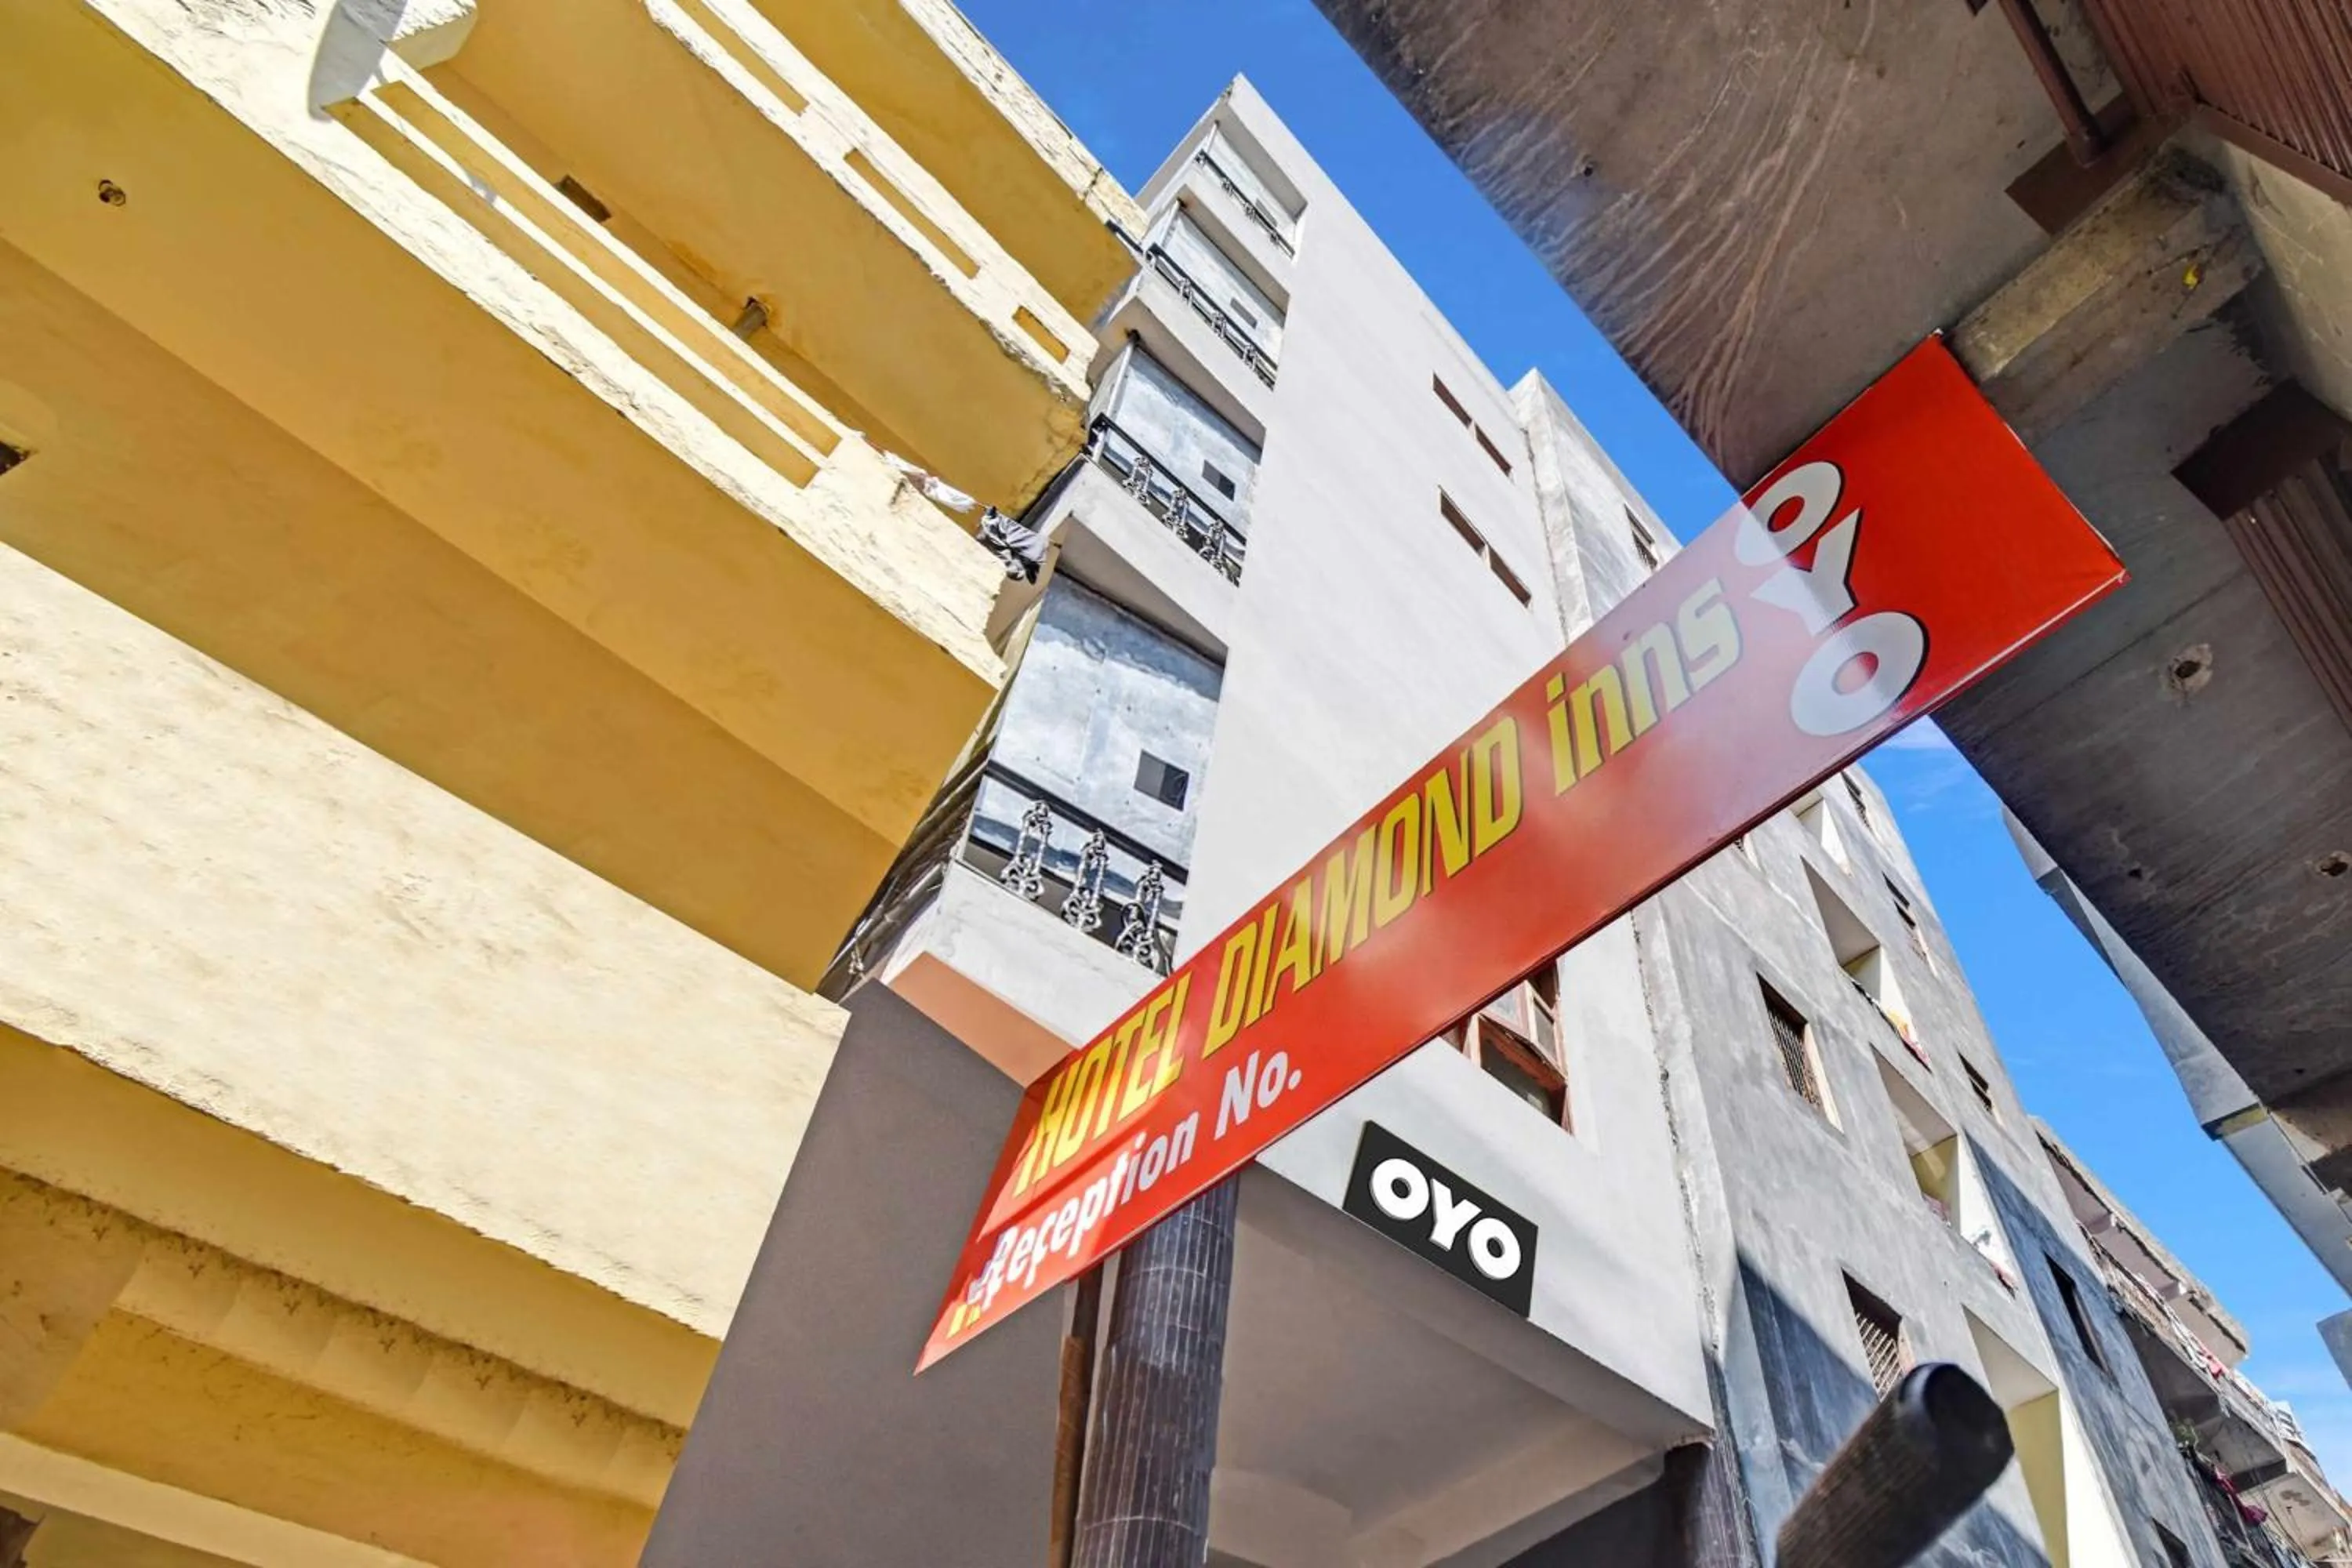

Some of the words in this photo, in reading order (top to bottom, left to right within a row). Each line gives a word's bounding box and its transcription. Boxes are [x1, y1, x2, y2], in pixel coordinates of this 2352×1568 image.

[1734, 461, 1929, 737] OYO
[1013, 970, 1192, 1198] HOTEL
[1201, 714, 1523, 1059] DIAMOND
[1546, 577, 1744, 797] inns
[977, 1111, 1199, 1309] Reception
[1214, 1051, 1302, 1141] No.
[1369, 1157, 1522, 1280] OYO
